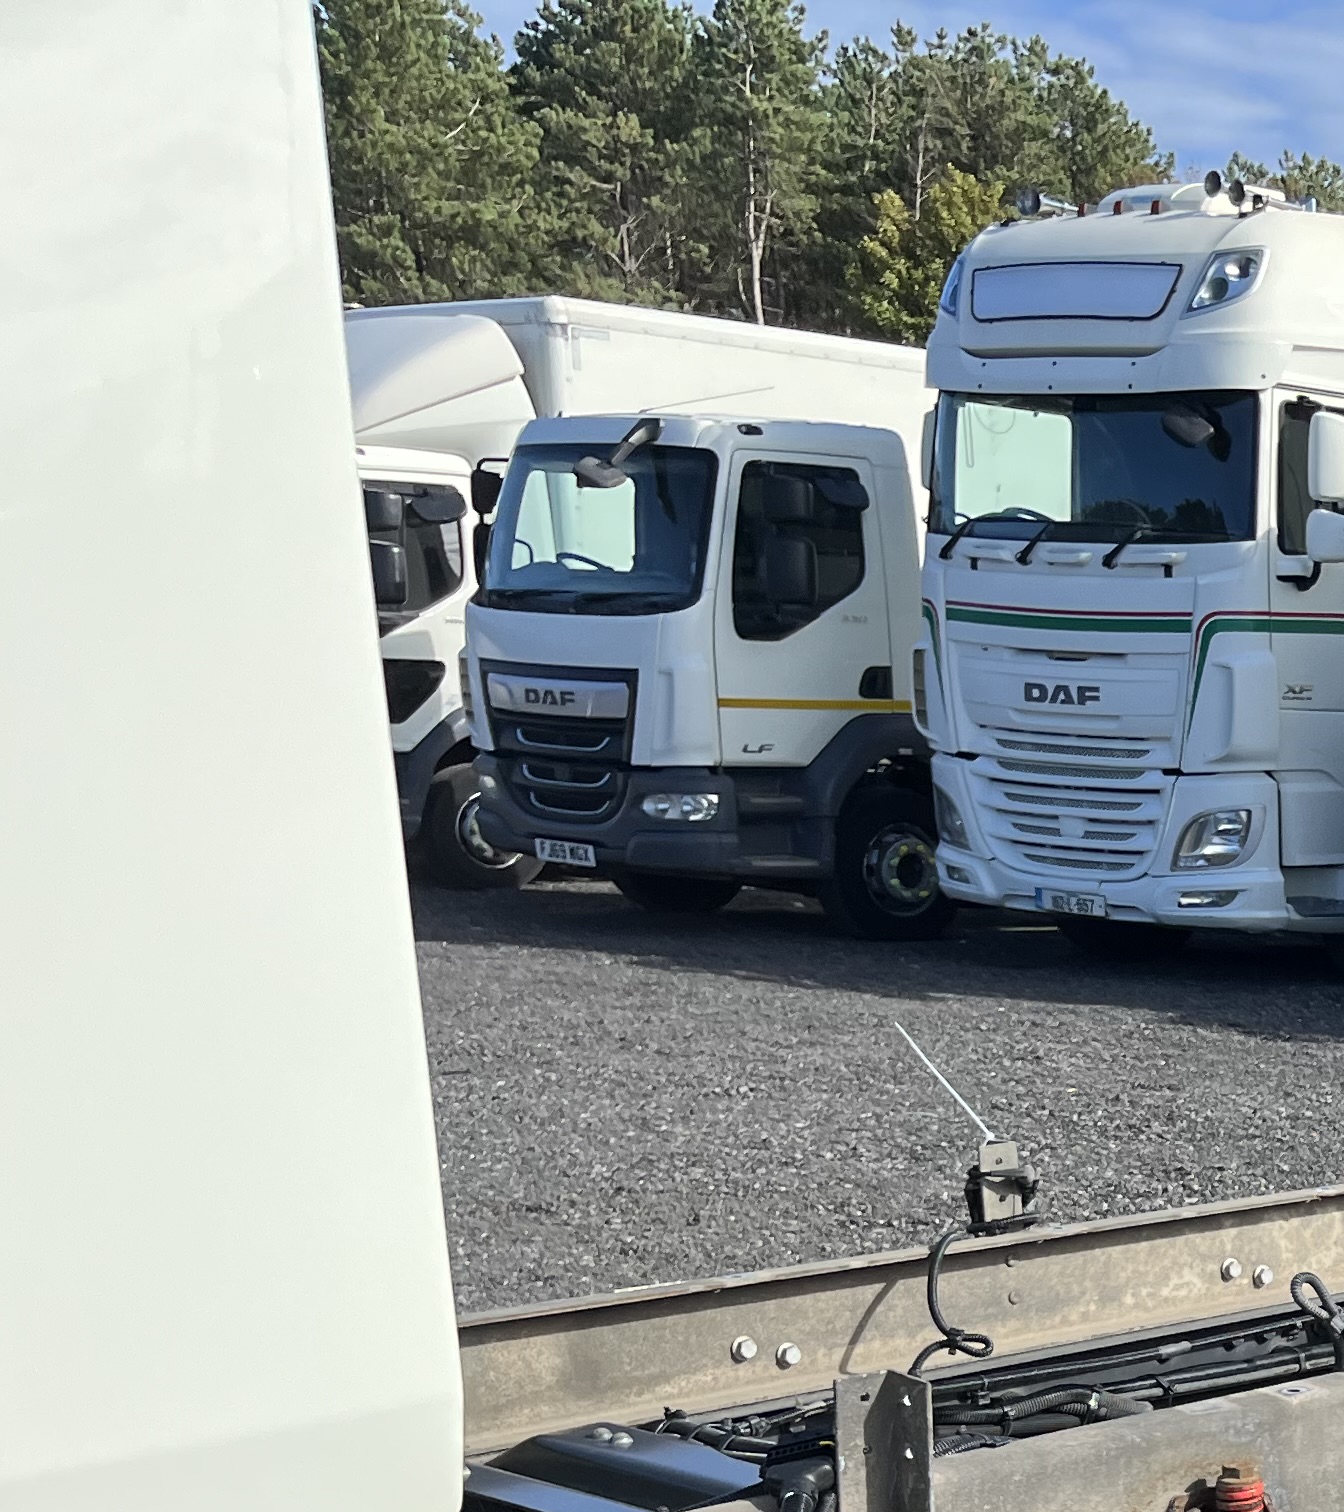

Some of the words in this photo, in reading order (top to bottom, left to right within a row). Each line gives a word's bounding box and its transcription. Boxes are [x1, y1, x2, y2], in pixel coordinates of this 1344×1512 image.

[524, 688, 575, 706] DAF
[1024, 682, 1101, 706] DAF
[741, 744, 774, 753] LF
